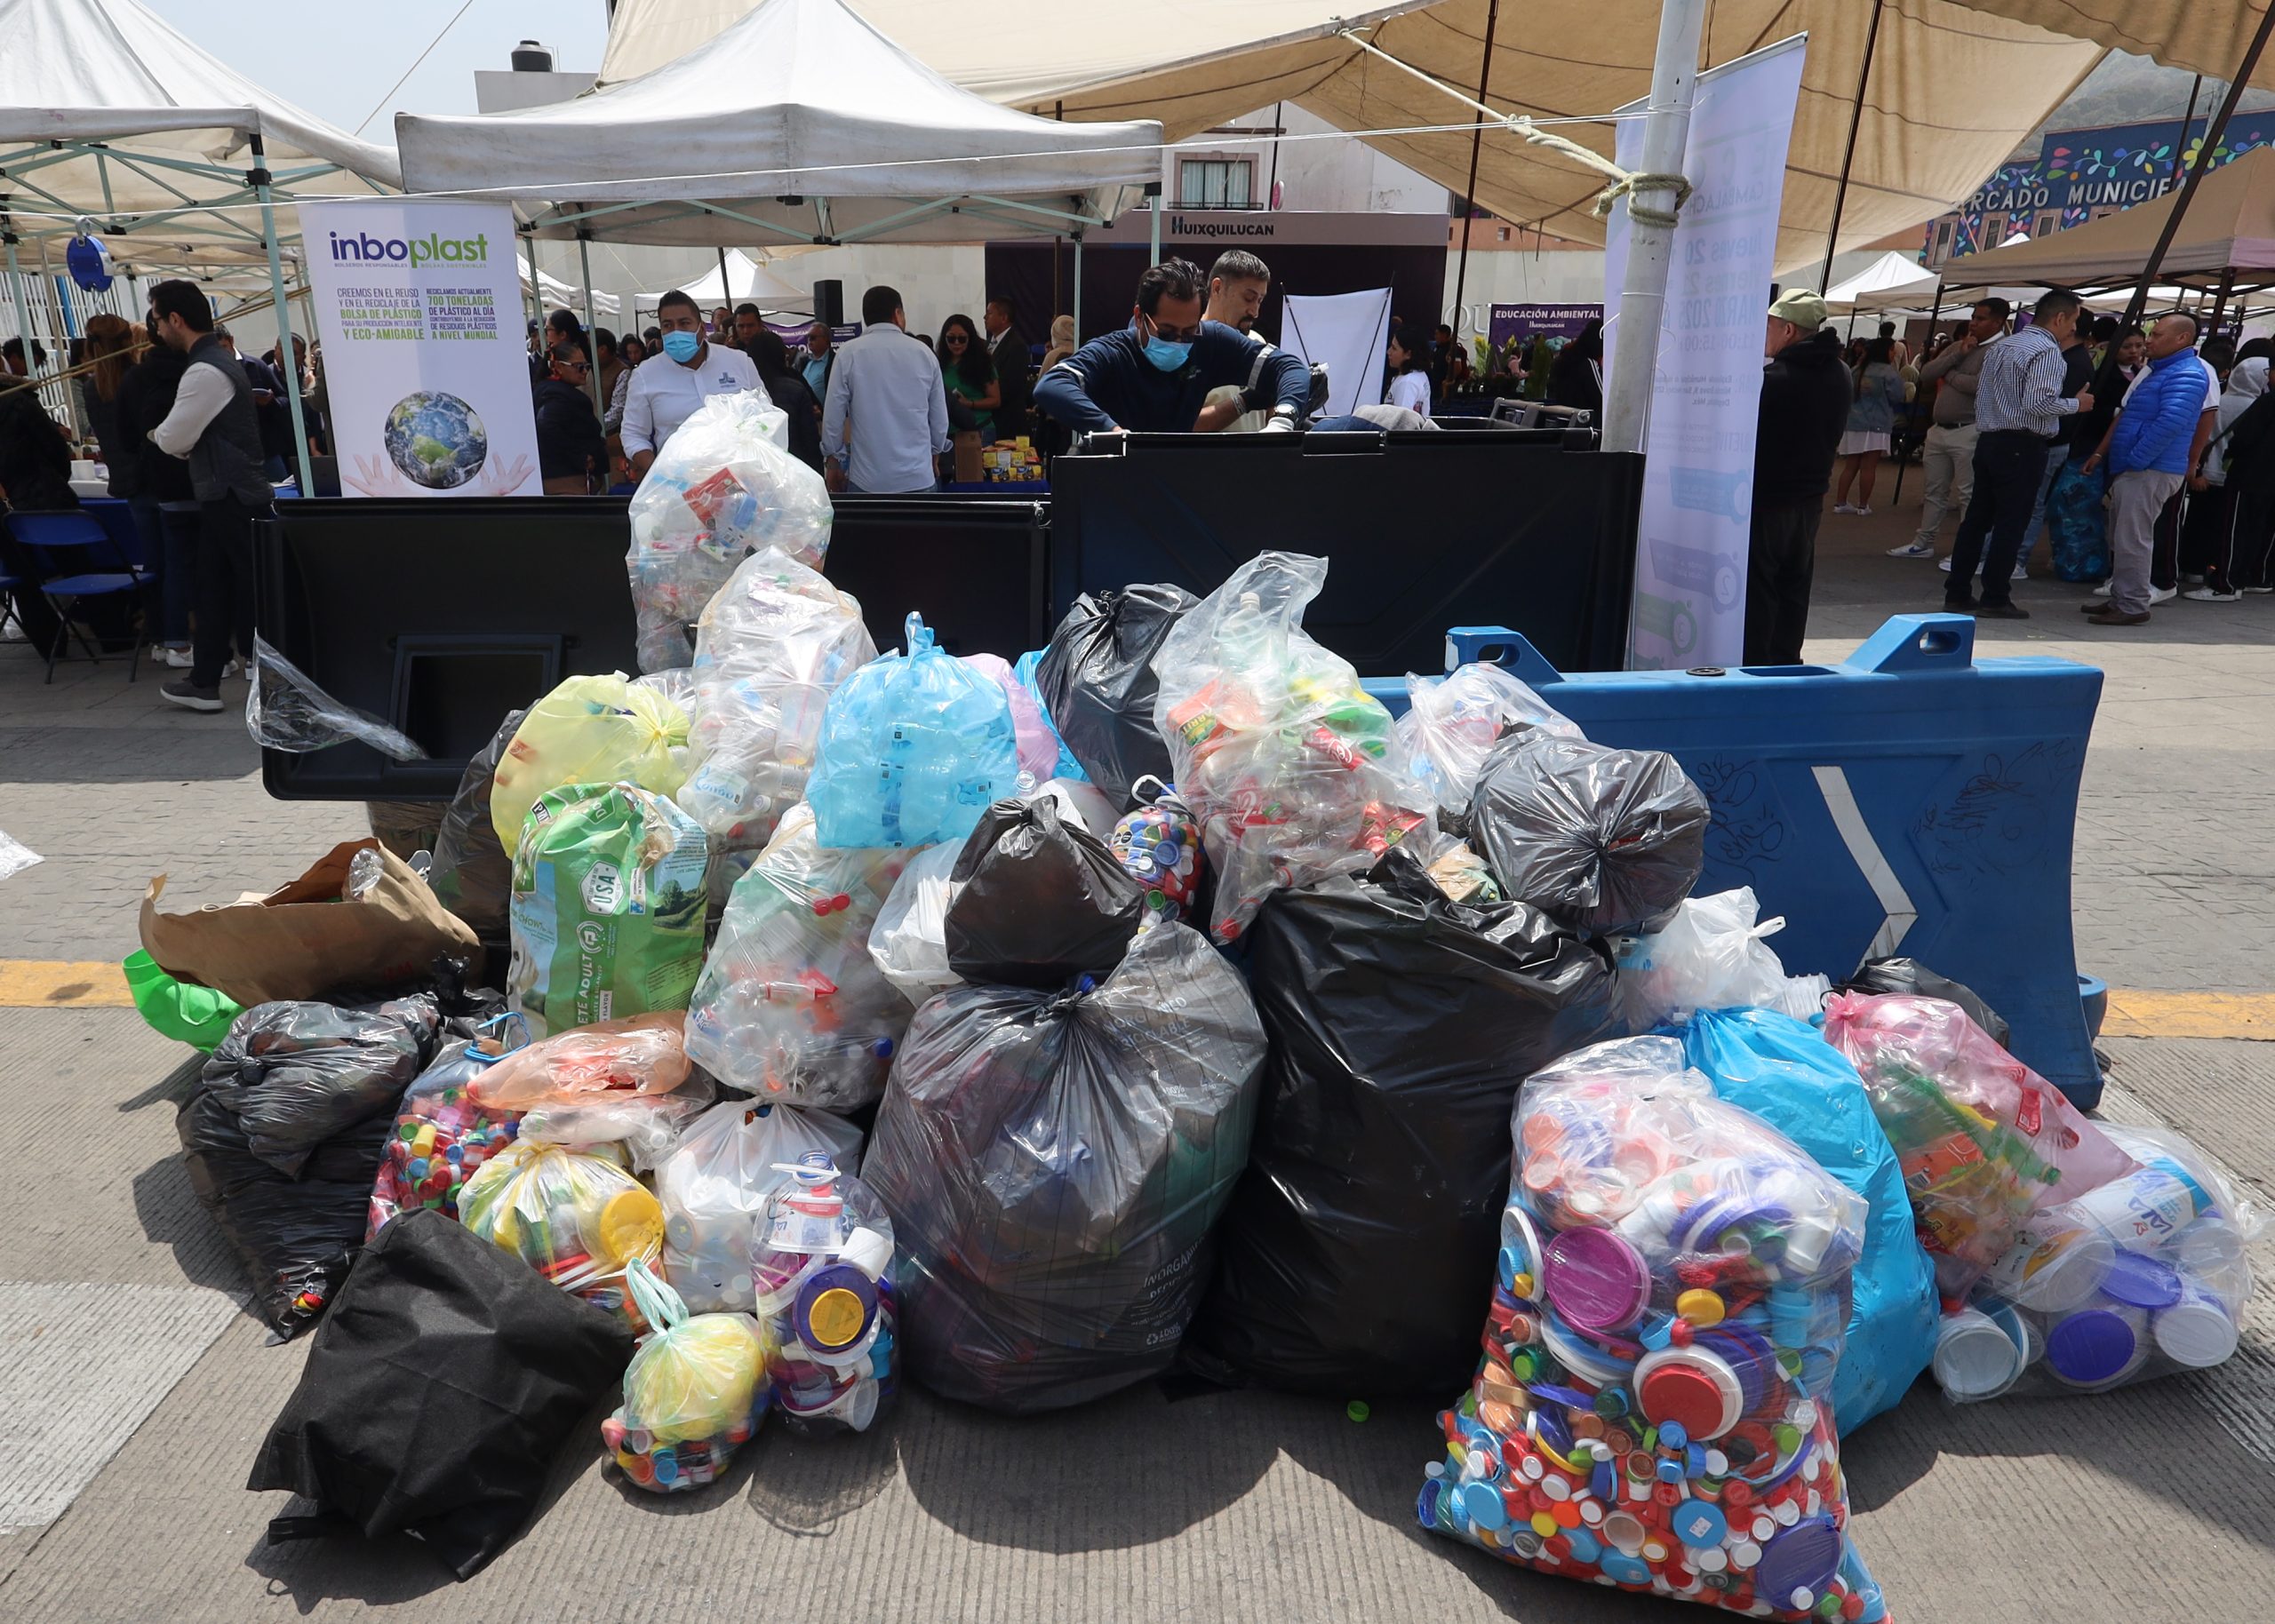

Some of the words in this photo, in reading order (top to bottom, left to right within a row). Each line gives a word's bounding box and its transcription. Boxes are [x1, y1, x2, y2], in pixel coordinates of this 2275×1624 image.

[1969, 187, 2049, 212] RCADO
[1171, 216, 1274, 237] HUIXQUILUCAN
[329, 231, 488, 268] inboplast
[337, 287, 372, 299] CREEMOS
[373, 287, 384, 299] EN
[385, 288, 395, 299] EL
[395, 288, 419, 298] REUSO
[339, 299, 343, 308] Y
[345, 299, 355, 308] EN
[355, 299, 364, 308] EL
[365, 299, 400, 308] RECICLAJE
[401, 299, 411, 308] DE
[411, 299, 421, 308] LA
[427, 295, 444, 306] 700
[445, 295, 494, 306] TONELADAS
[340, 308, 368, 320] BOLSA
[369, 308, 381, 320] DE
[382, 306, 422, 320] PLÁSTICO
[428, 306, 438, 316] DE
[439, 305, 472, 316] PLÁSTICO
[473, 306, 483, 316] AL
[483, 305, 495, 316] DÍA
[1495, 308, 1549, 319] EDUCACIÓN
[1549, 309, 1600, 319] AMBIENTAL
[467, 321, 498, 330] PLÁSTICOS
[1443, 303, 1489, 341] QU
[343, 328, 349, 340] Y
[352, 328, 425, 340] ECO-AMIGABLE
[432, 330, 437, 340] A
[439, 330, 462, 340] NIVEL
[463, 330, 499, 340] MUNDIAL
[593, 875, 616, 904] USA
[578, 953, 594, 999] ADULT
[577, 1000, 588, 1024] ETE
